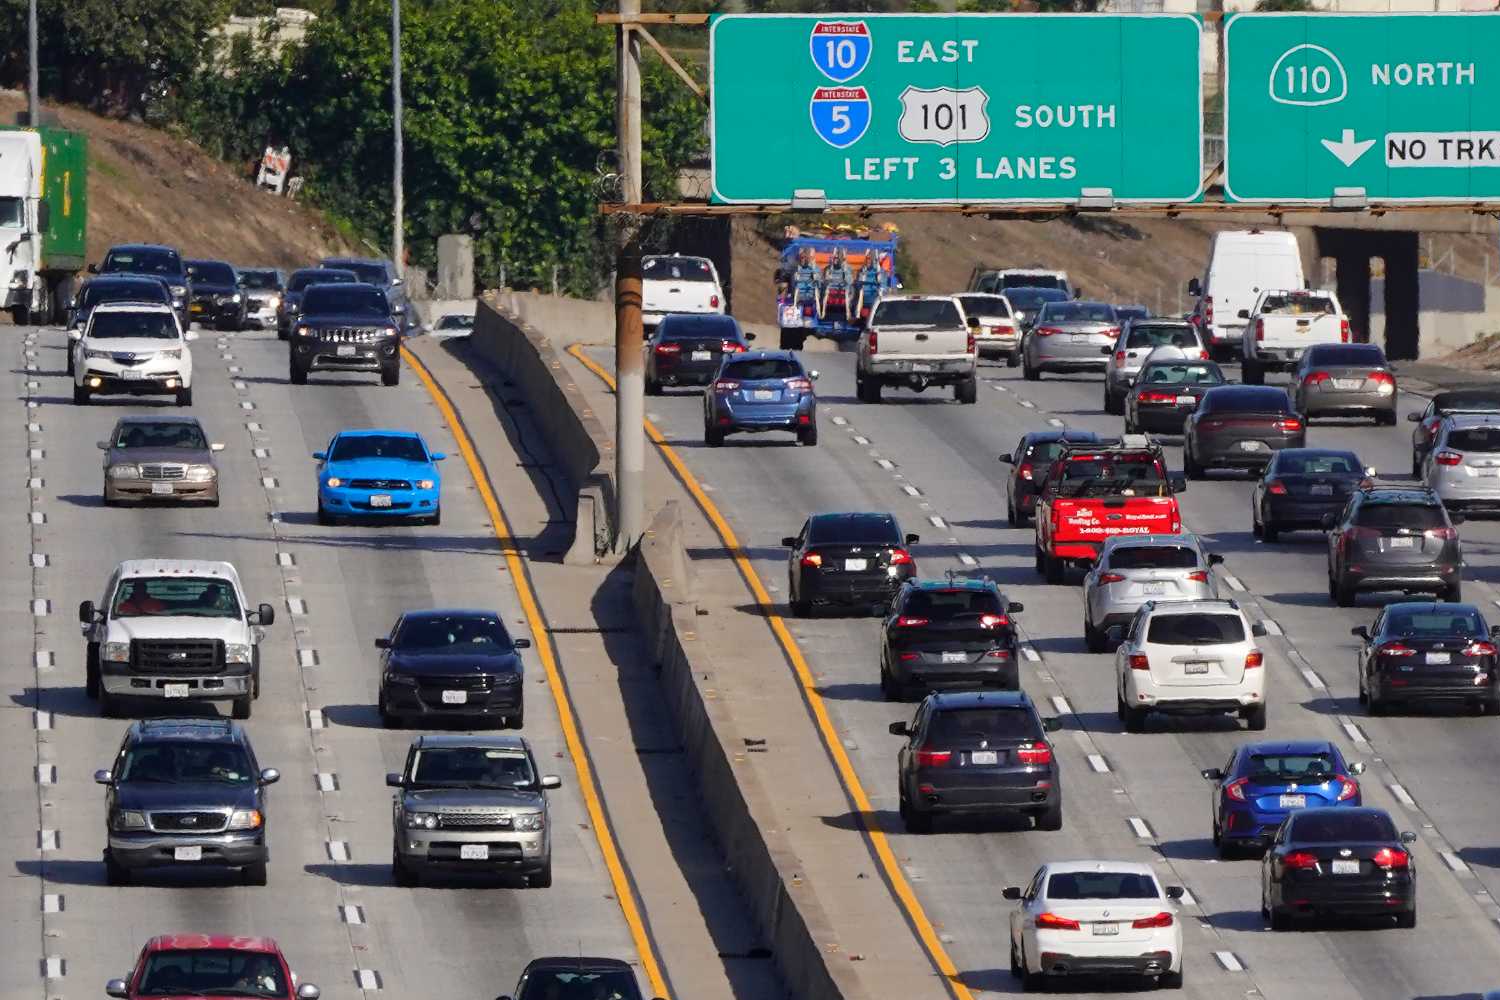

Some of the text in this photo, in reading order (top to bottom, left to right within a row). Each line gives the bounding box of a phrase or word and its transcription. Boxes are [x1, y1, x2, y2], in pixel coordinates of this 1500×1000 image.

[820, 25, 860, 33] INTERSTATE
[826, 40, 979, 69] 10 EAST
[1285, 63, 1475, 94] 110 NORTH
[831, 104, 1115, 134] 5 101 SOUTH
[1388, 138, 1426, 161] NO
[845, 157, 1077, 181] LEFT 3 LANES
